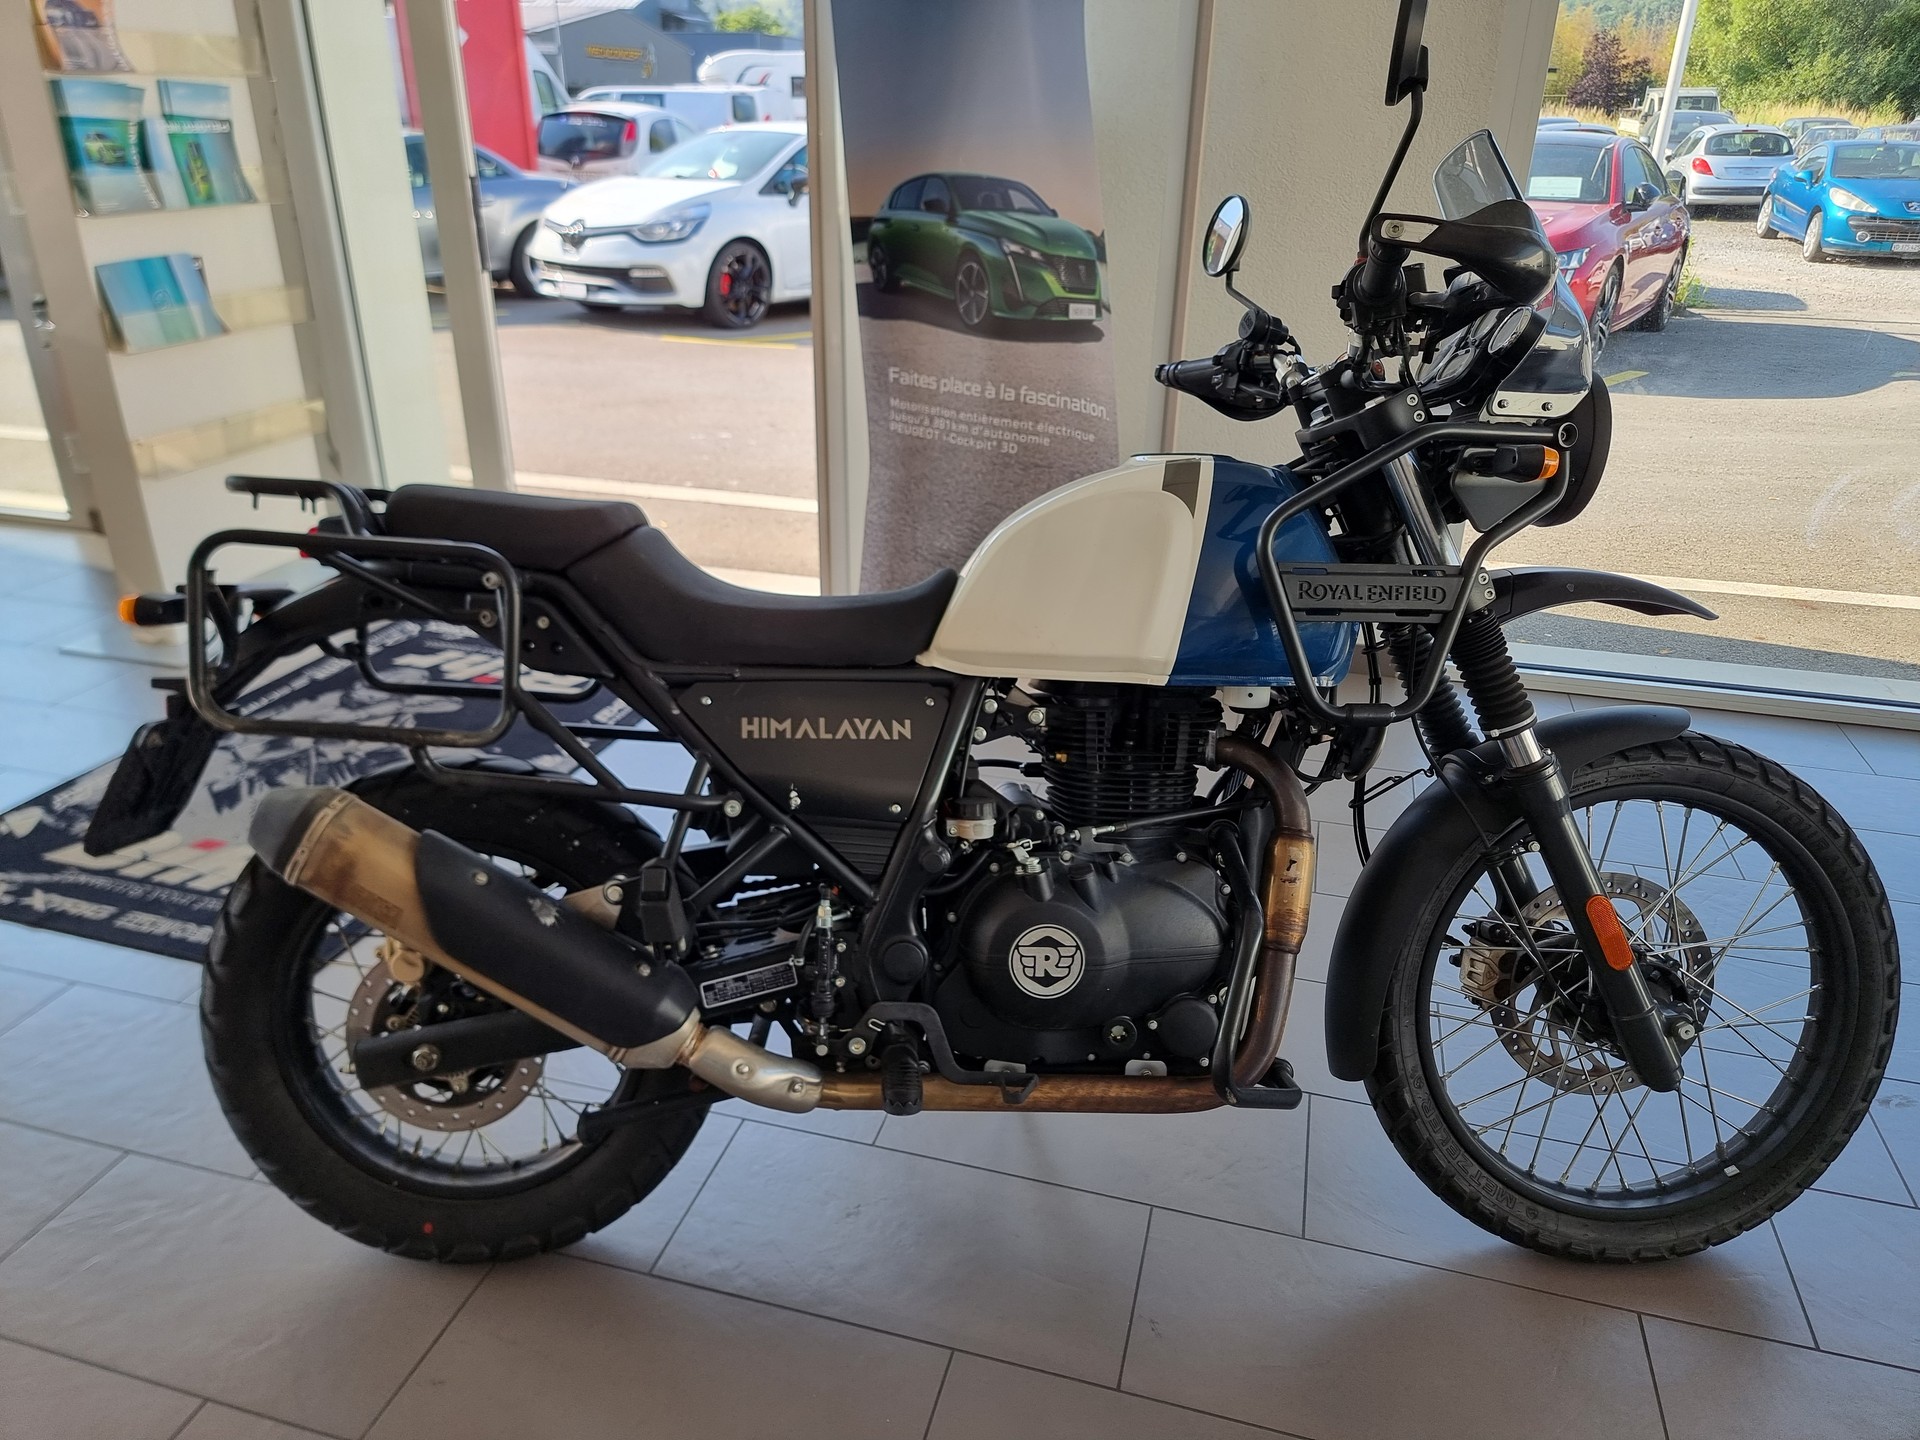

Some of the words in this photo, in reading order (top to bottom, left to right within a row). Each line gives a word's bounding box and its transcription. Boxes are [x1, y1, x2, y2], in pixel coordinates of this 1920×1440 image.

[888, 366, 938, 392] Faites
[940, 376, 982, 397] place
[984, 381, 996, 400] à
[1000, 383, 1015, 402] la
[1020, 385, 1112, 421] fascination.
[890, 397, 957, 419] Motorisation
[959, 410, 1034, 430] entièrement
[1036, 422, 1096, 443] électrique
[890, 421, 940, 441] PEUGEOT
[1001, 442, 1018, 455] 3D
[1298, 580, 1363, 602] ROYAL
[1366, 584, 1447, 605] ENFIELD
[741, 716, 912, 740] HIMALAYAN
[1421, 1098, 1518, 1210] METZELER
